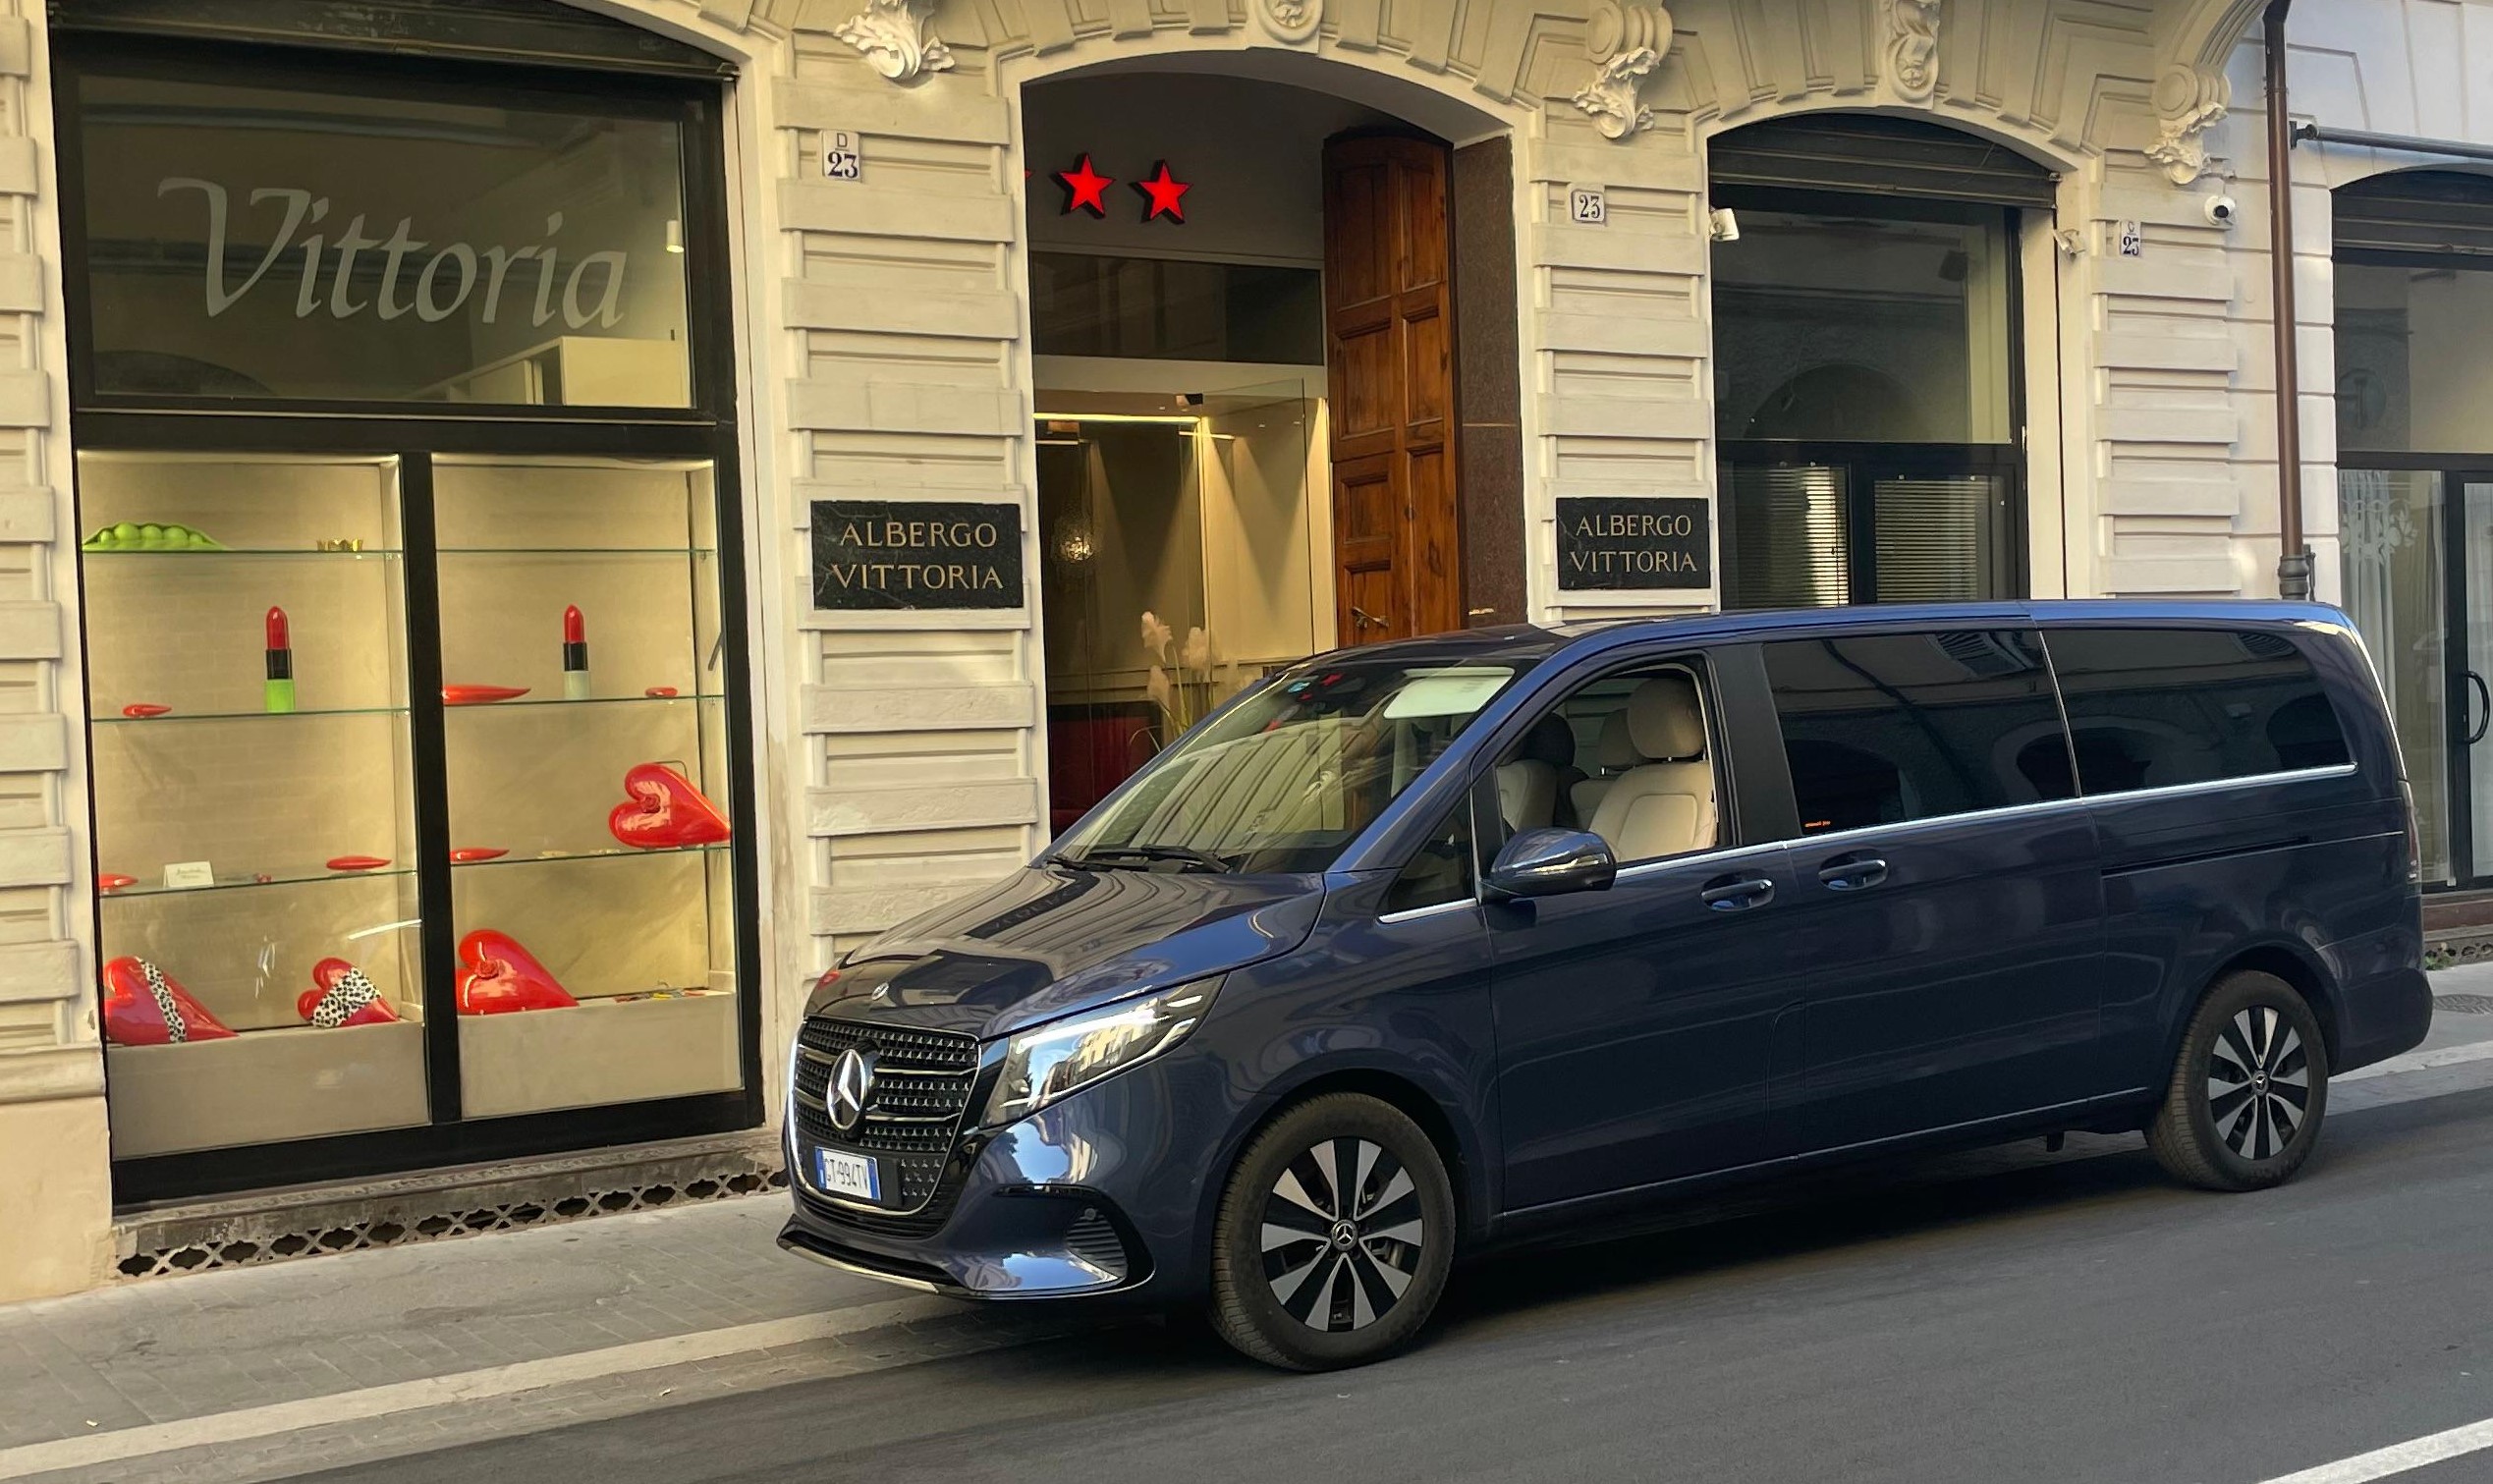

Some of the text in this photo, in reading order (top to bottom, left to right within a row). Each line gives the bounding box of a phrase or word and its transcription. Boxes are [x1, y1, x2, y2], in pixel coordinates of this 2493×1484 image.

[836, 133, 848, 147] D
[827, 151, 858, 178] 23
[1579, 194, 1600, 219] 23
[157, 177, 628, 329] Vittoria
[2123, 236, 2139, 255] 23
[839, 522, 998, 547] ALBERGO
[1576, 515, 1692, 537] ALBERGO
[1570, 551, 1697, 573] VITTORIA
[831, 563, 1005, 589] VITTORIA
